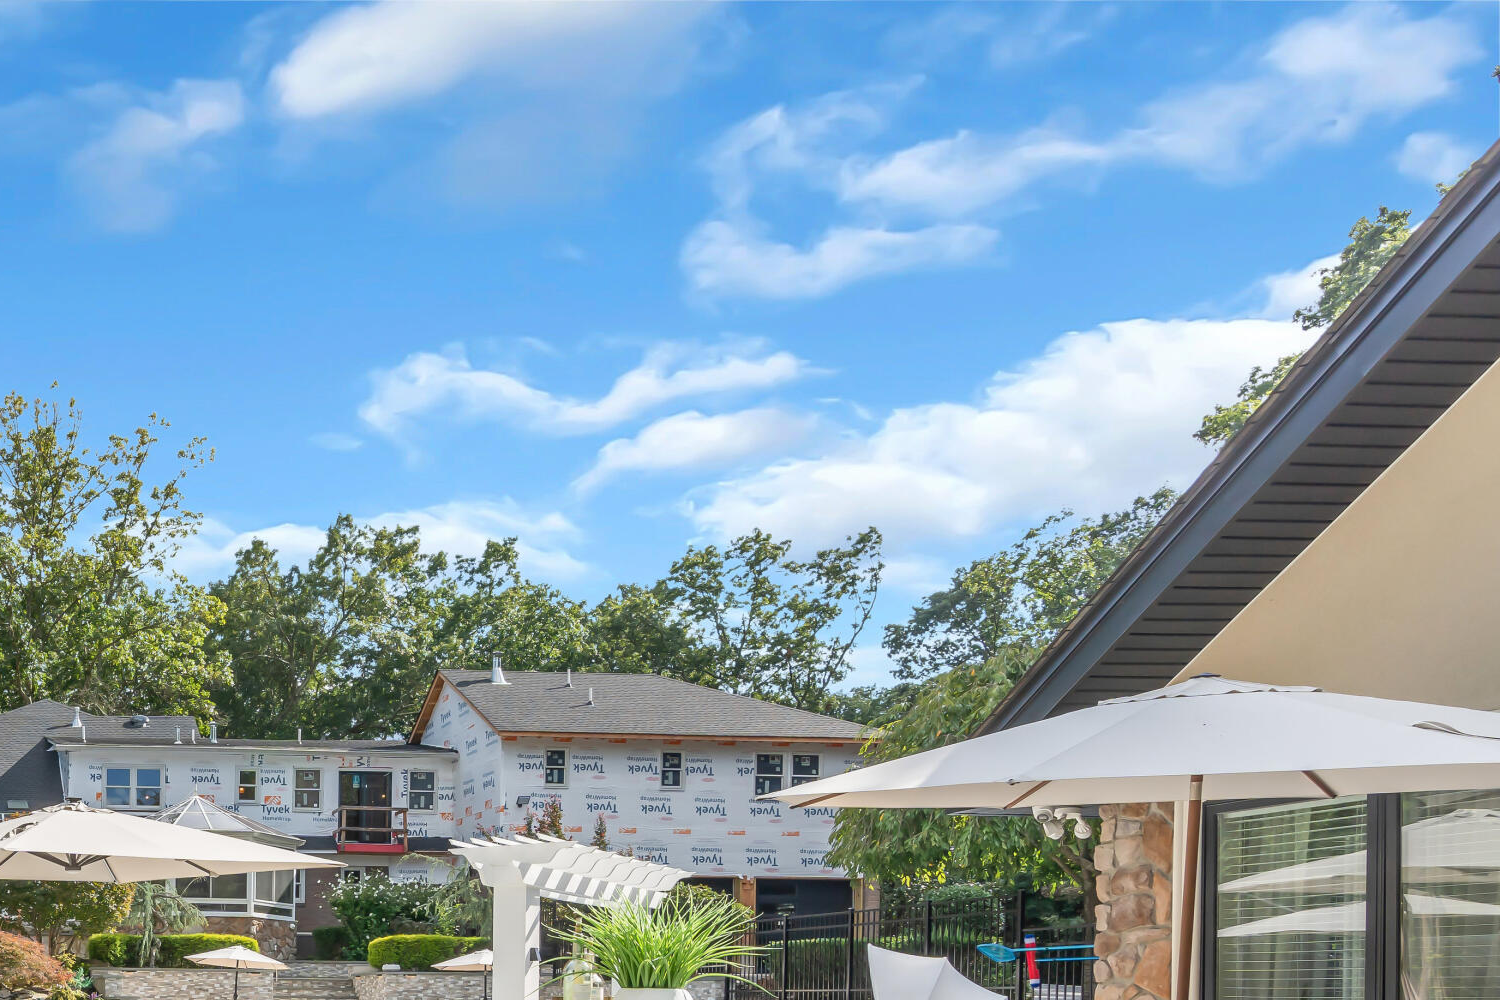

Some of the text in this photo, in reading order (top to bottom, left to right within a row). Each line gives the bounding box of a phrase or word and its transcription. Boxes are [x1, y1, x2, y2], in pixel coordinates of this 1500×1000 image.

[573, 763, 605, 774] Tyvek
[628, 764, 660, 775] Tyvek
[191, 775, 221, 785] Tyvek
[260, 804, 290, 815] Tyvek
[586, 803, 618, 813] Tyvek
[641, 804, 672, 815] Tyvek
[695, 805, 727, 816] Tyvek
[749, 806, 781, 817] Tyvek
[406, 829, 428, 838] Tyve
[692, 854, 724, 865] Tyvek
[746, 855, 779, 866] Tyvek
